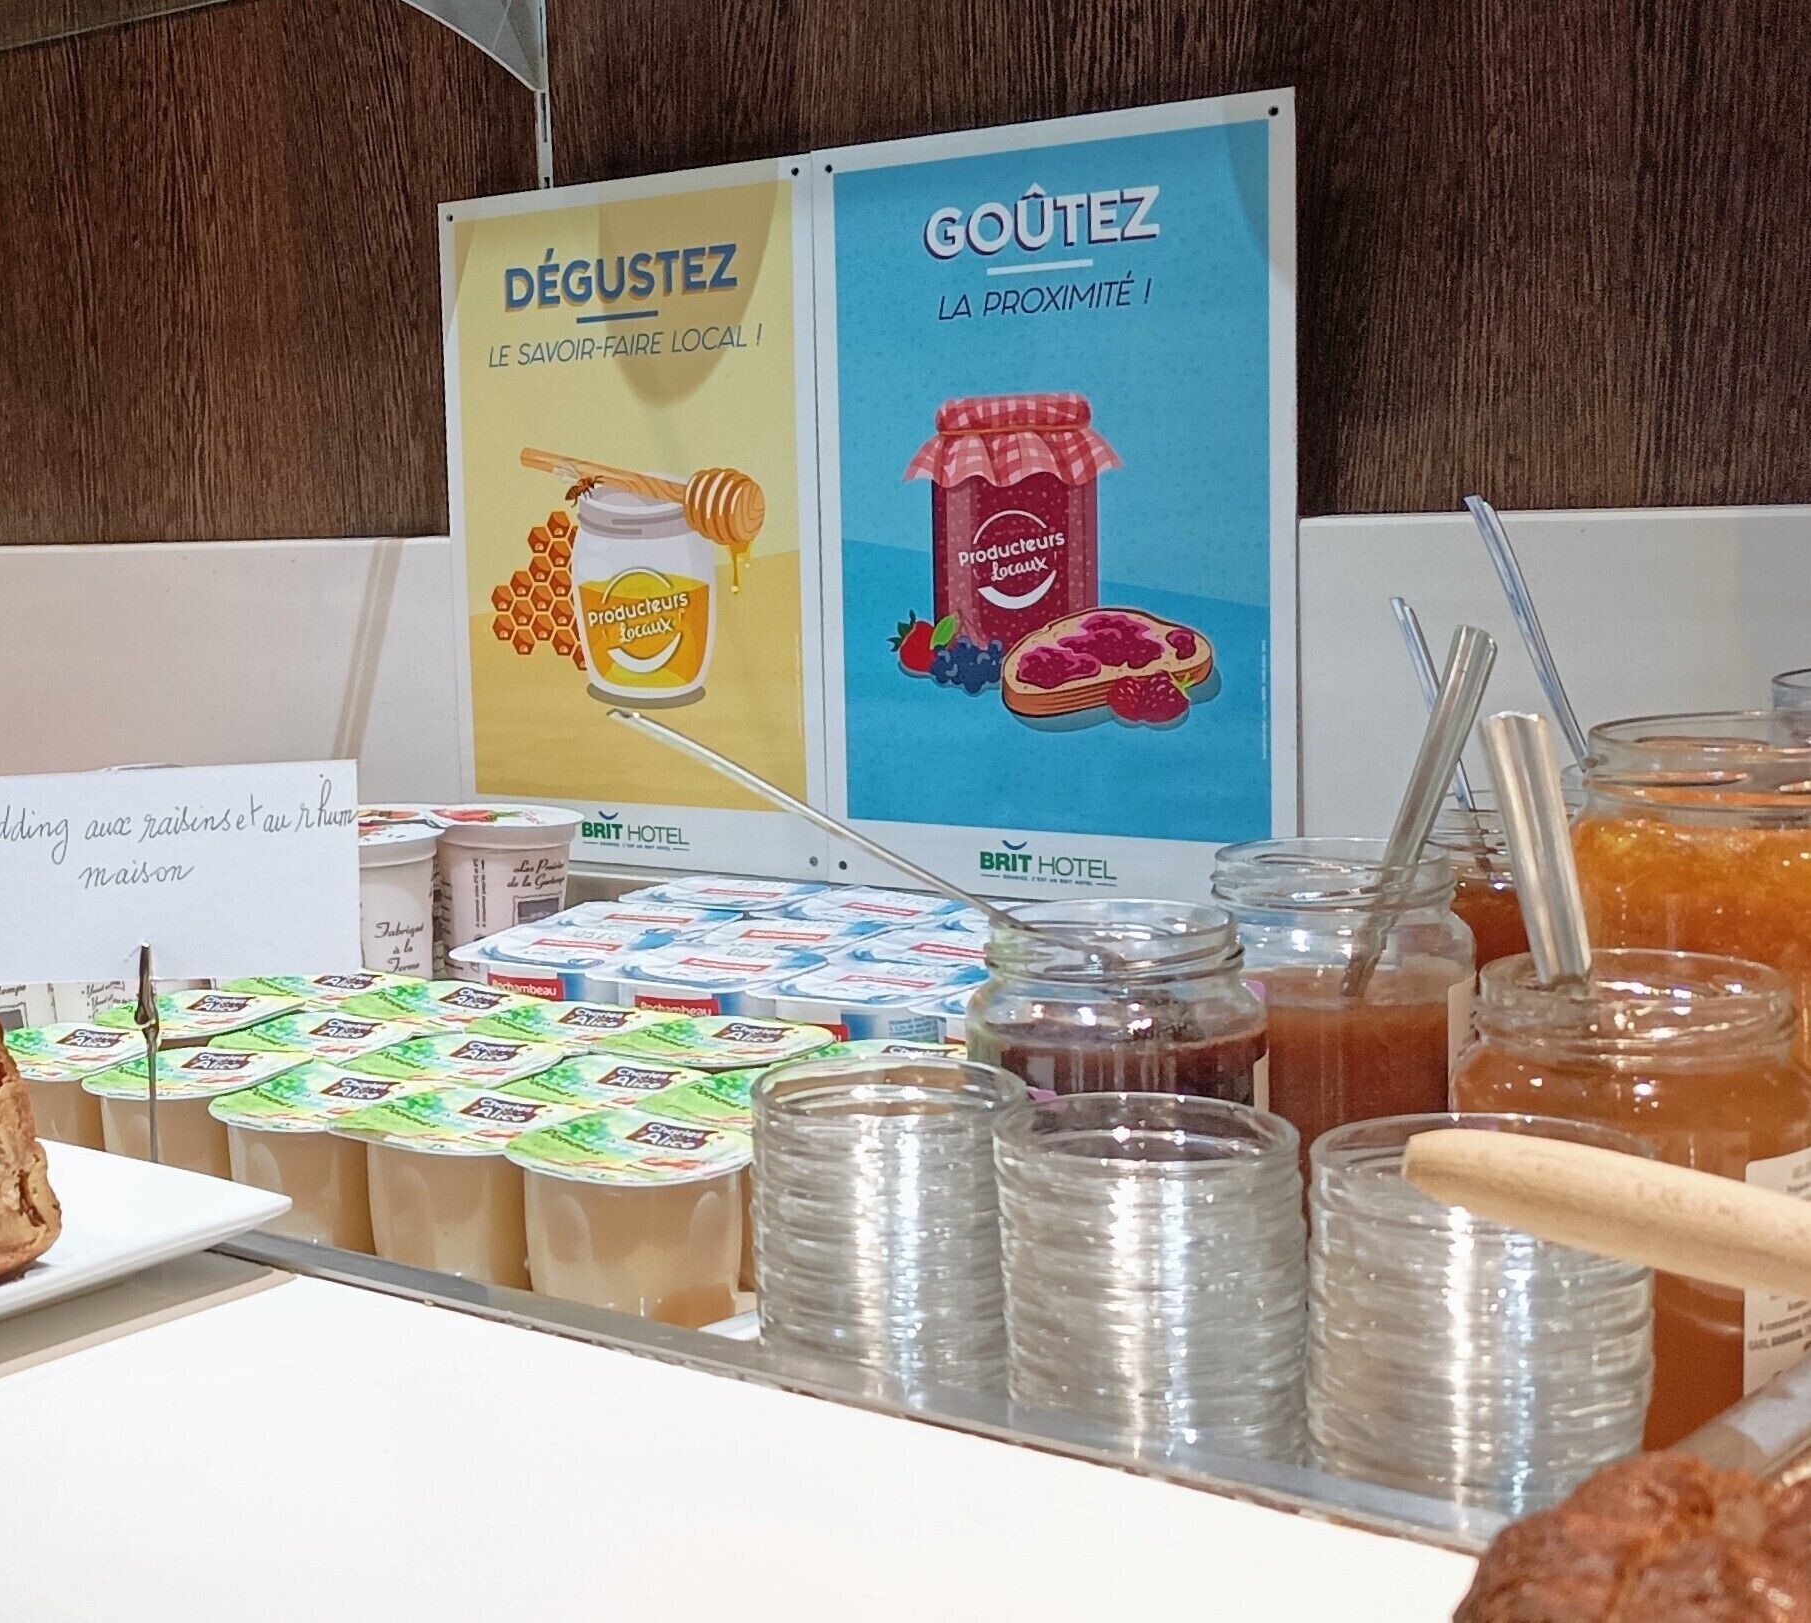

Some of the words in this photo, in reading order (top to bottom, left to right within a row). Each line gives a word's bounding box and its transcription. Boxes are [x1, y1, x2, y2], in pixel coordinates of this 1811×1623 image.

[924, 182, 1161, 260] GOÛTEZ
[505, 243, 739, 312] DÉGUSTEZ
[938, 295, 973, 321] LA
[982, 270, 1135, 318] PROXIMITÉ
[489, 345, 509, 368] LE
[517, 331, 665, 366] SAVOIR-FAIRE
[671, 325, 748, 354] LOCAL
[958, 530, 1066, 567] Producteurs
[990, 554, 1049, 582] Locaux
[588, 591, 689, 628] Producteurs
[617, 616, 674, 644] Locaux
[84, 814, 132, 841] aux
[139, 805, 232, 845] raisins
[235, 794, 264, 831] et
[262, 810, 293, 834] au
[581, 821, 624, 840] BRIT
[627, 824, 690, 846] HOTEL
[78, 862, 195, 890] maison
[979, 850, 1033, 873] BRIT
[1038, 855, 1118, 881] HOTEL
[567, 1015, 619, 1028] Alice
[725, 1031, 777, 1043] Alice
[612, 1075, 662, 1090] Alice
[640, 1132, 696, 1150] Alice
